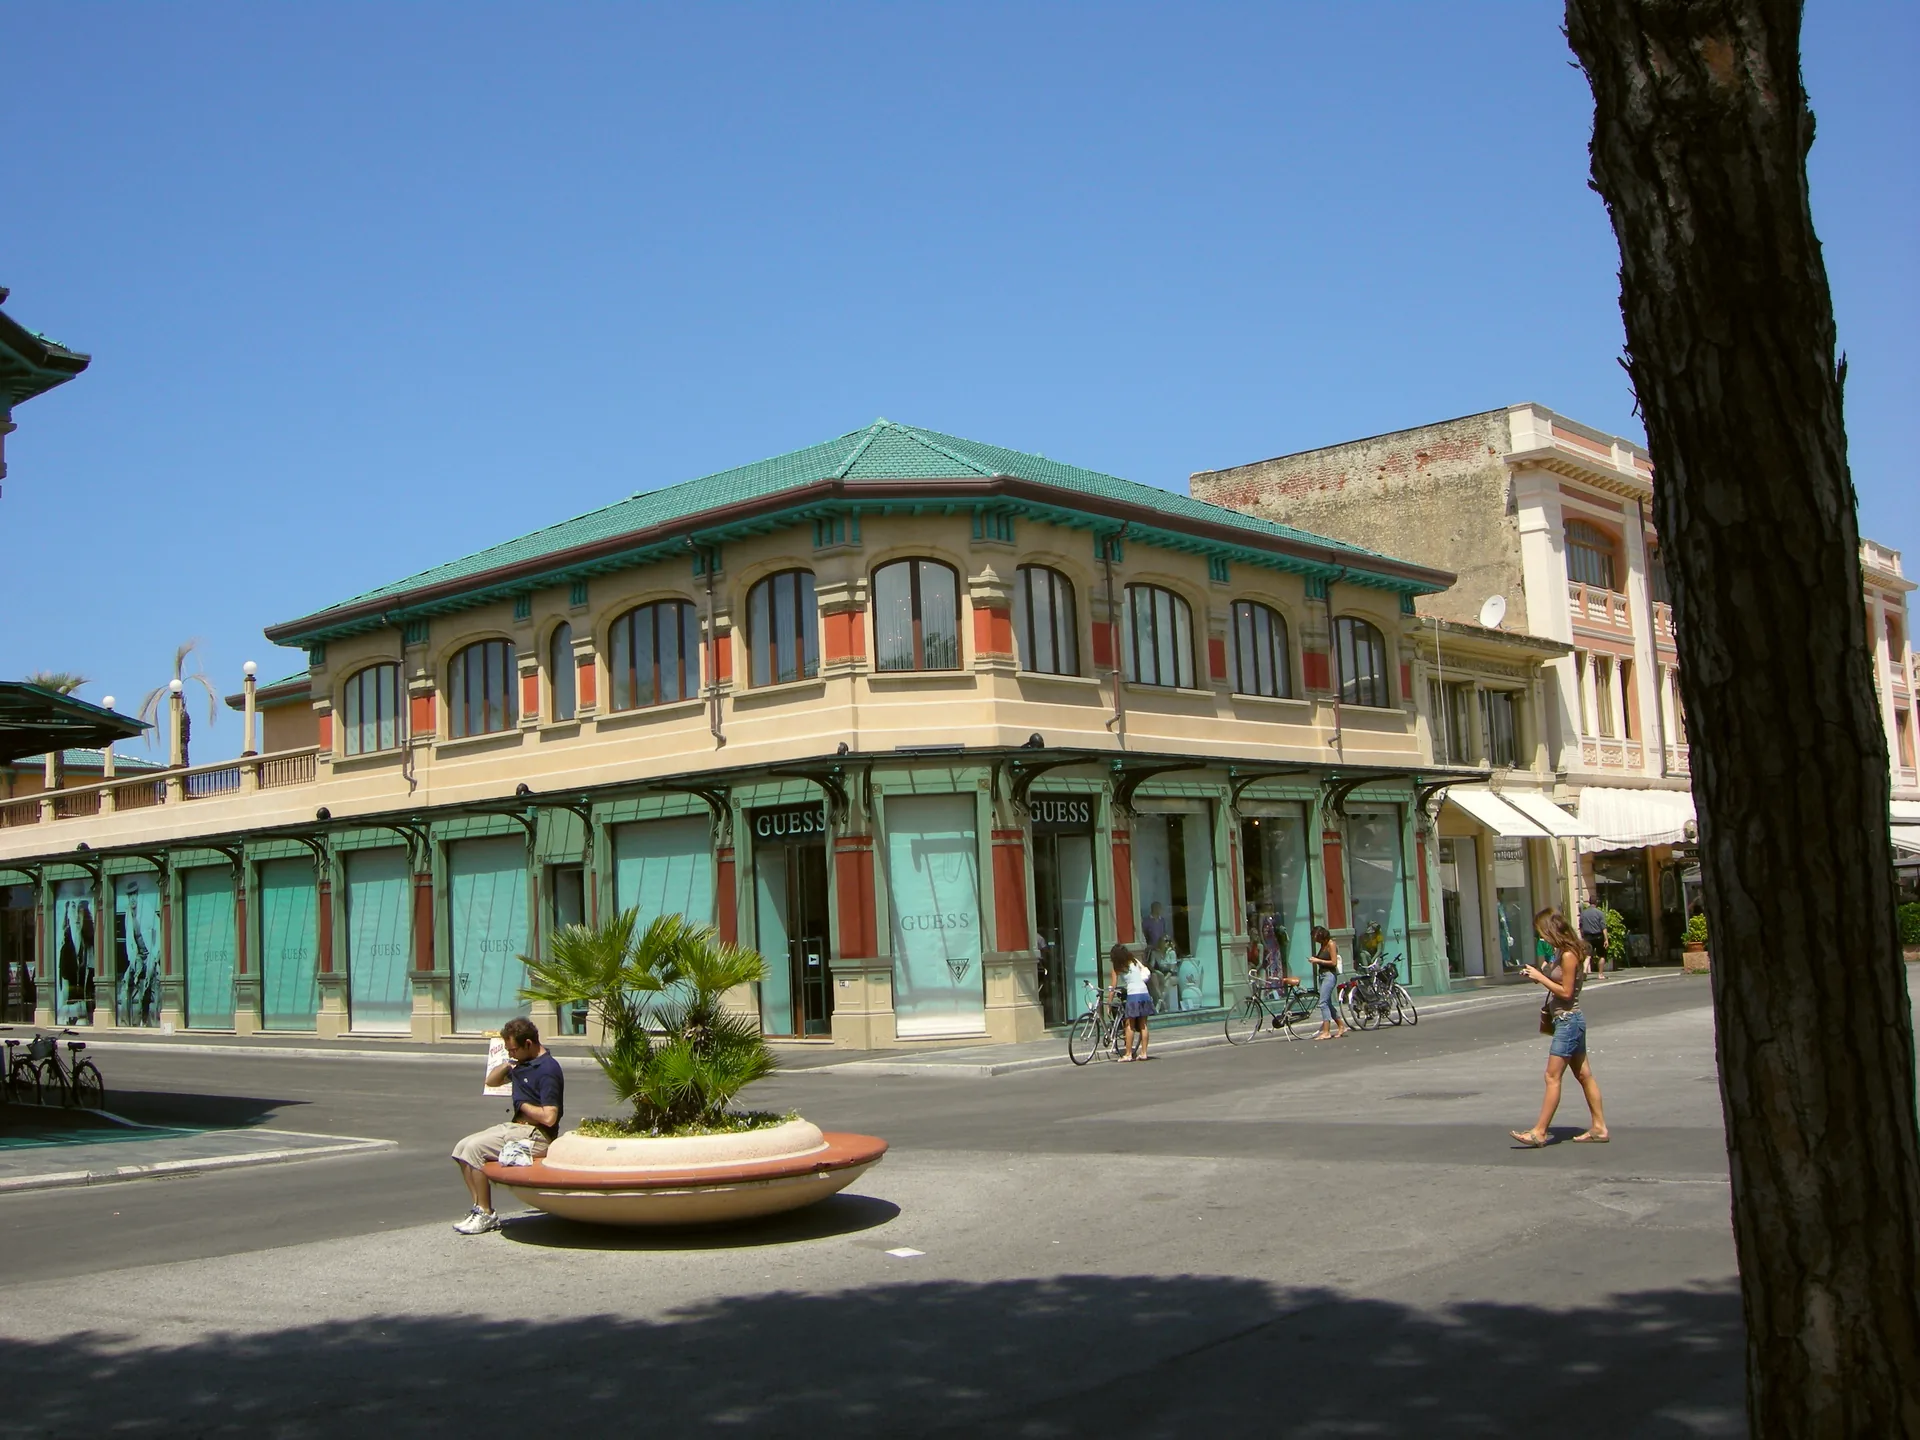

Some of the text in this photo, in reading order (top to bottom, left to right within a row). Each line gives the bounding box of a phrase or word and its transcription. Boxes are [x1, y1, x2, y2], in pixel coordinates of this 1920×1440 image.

[1029, 800, 1089, 823] GUESS
[756, 809, 826, 837] GUESS
[900, 912, 969, 931] GUESS
[370, 943, 401, 957] GUESS
[479, 938, 515, 953] GUESS
[203, 950, 229, 962] GUESS
[281, 947, 309, 960] GUESS
